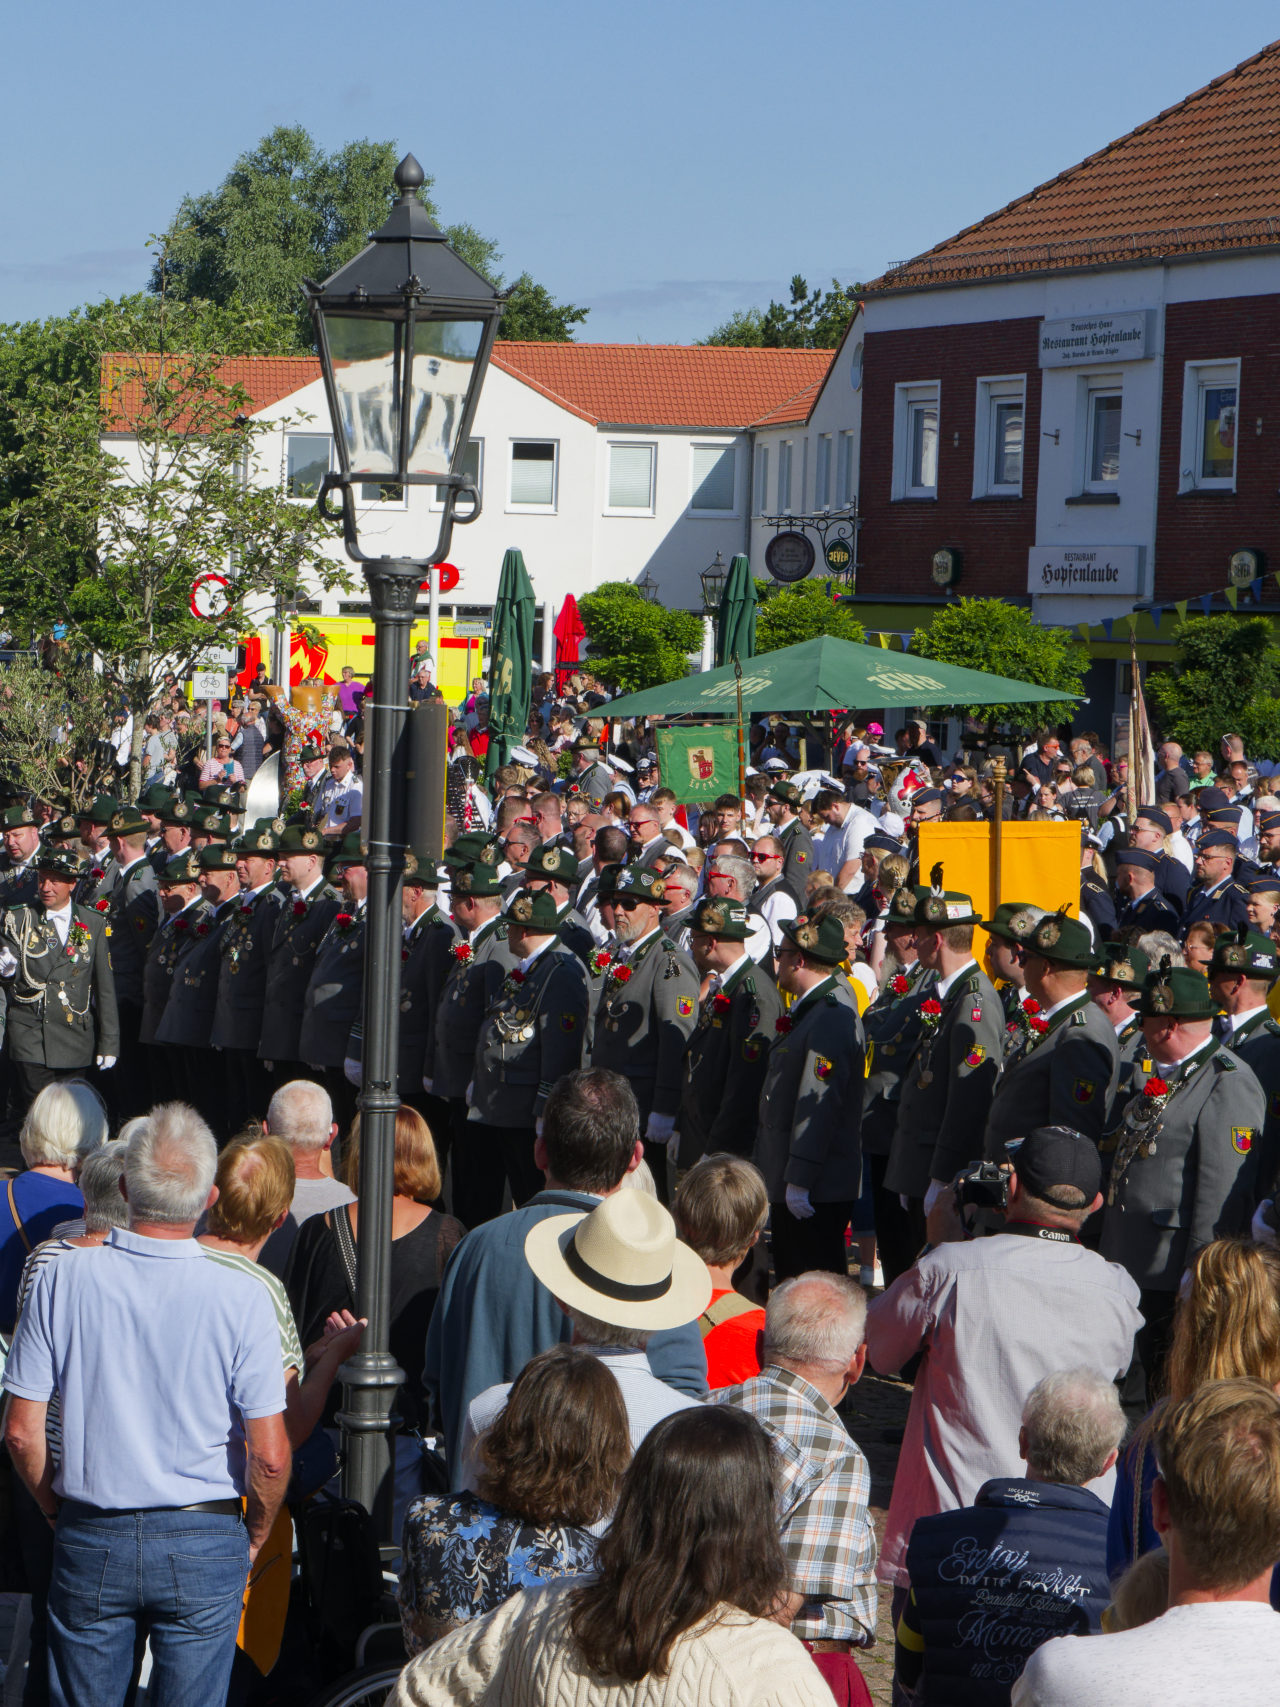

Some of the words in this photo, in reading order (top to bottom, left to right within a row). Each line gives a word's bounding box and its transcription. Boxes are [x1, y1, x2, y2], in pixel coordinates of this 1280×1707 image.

[1042, 335, 1088, 350] Restaurant
[1090, 328, 1142, 346] Hopfenlaube
[828, 551, 849, 563] JEVER
[1064, 552, 1097, 562] RESTAURANT
[1041, 562, 1119, 588] Hopfenlaube
[866, 672, 947, 691] JEVER
[1038, 1229, 1070, 1243] Canon
[938, 1536, 1030, 1584] Enjoy
